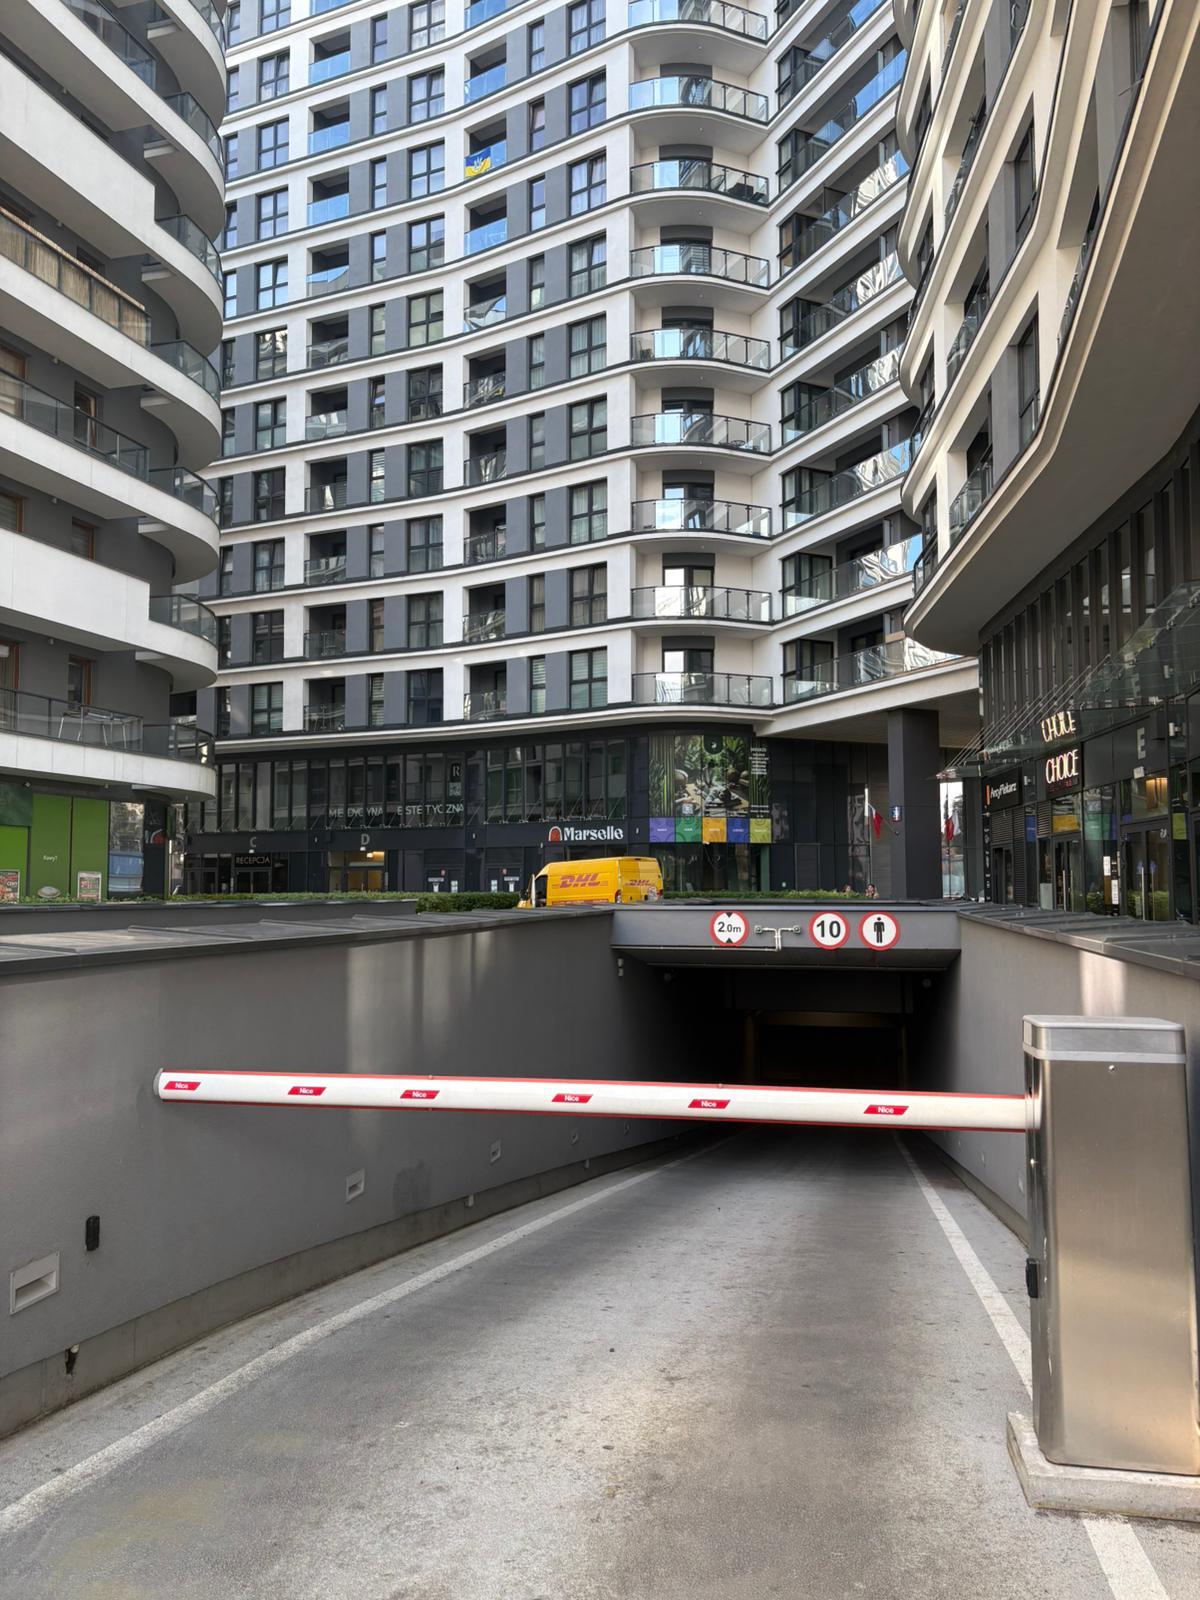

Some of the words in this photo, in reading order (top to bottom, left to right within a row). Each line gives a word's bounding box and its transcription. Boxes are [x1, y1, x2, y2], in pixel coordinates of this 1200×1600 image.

[1137, 727, 1146, 759] E
[1045, 749, 1079, 784] CHOICE
[329, 807, 384, 818] MEDYCYNA
[397, 804, 464, 816] ESTETYCZNA
[563, 826, 624, 841] Marselle
[250, 837, 257, 847] C
[361, 834, 370, 845] D
[236, 856, 270, 865] RECEPCJA
[560, 872, 600, 888] DHL
[816, 920, 841, 938] 10
[174, 1082, 189, 1090] Nice
[299, 1087, 314, 1095] Nice
[412, 1090, 427, 1098] Nice
[564, 1094, 580, 1102] Nice
[701, 1100, 717, 1108] Nice
[877, 1106, 894, 1114] Nice
